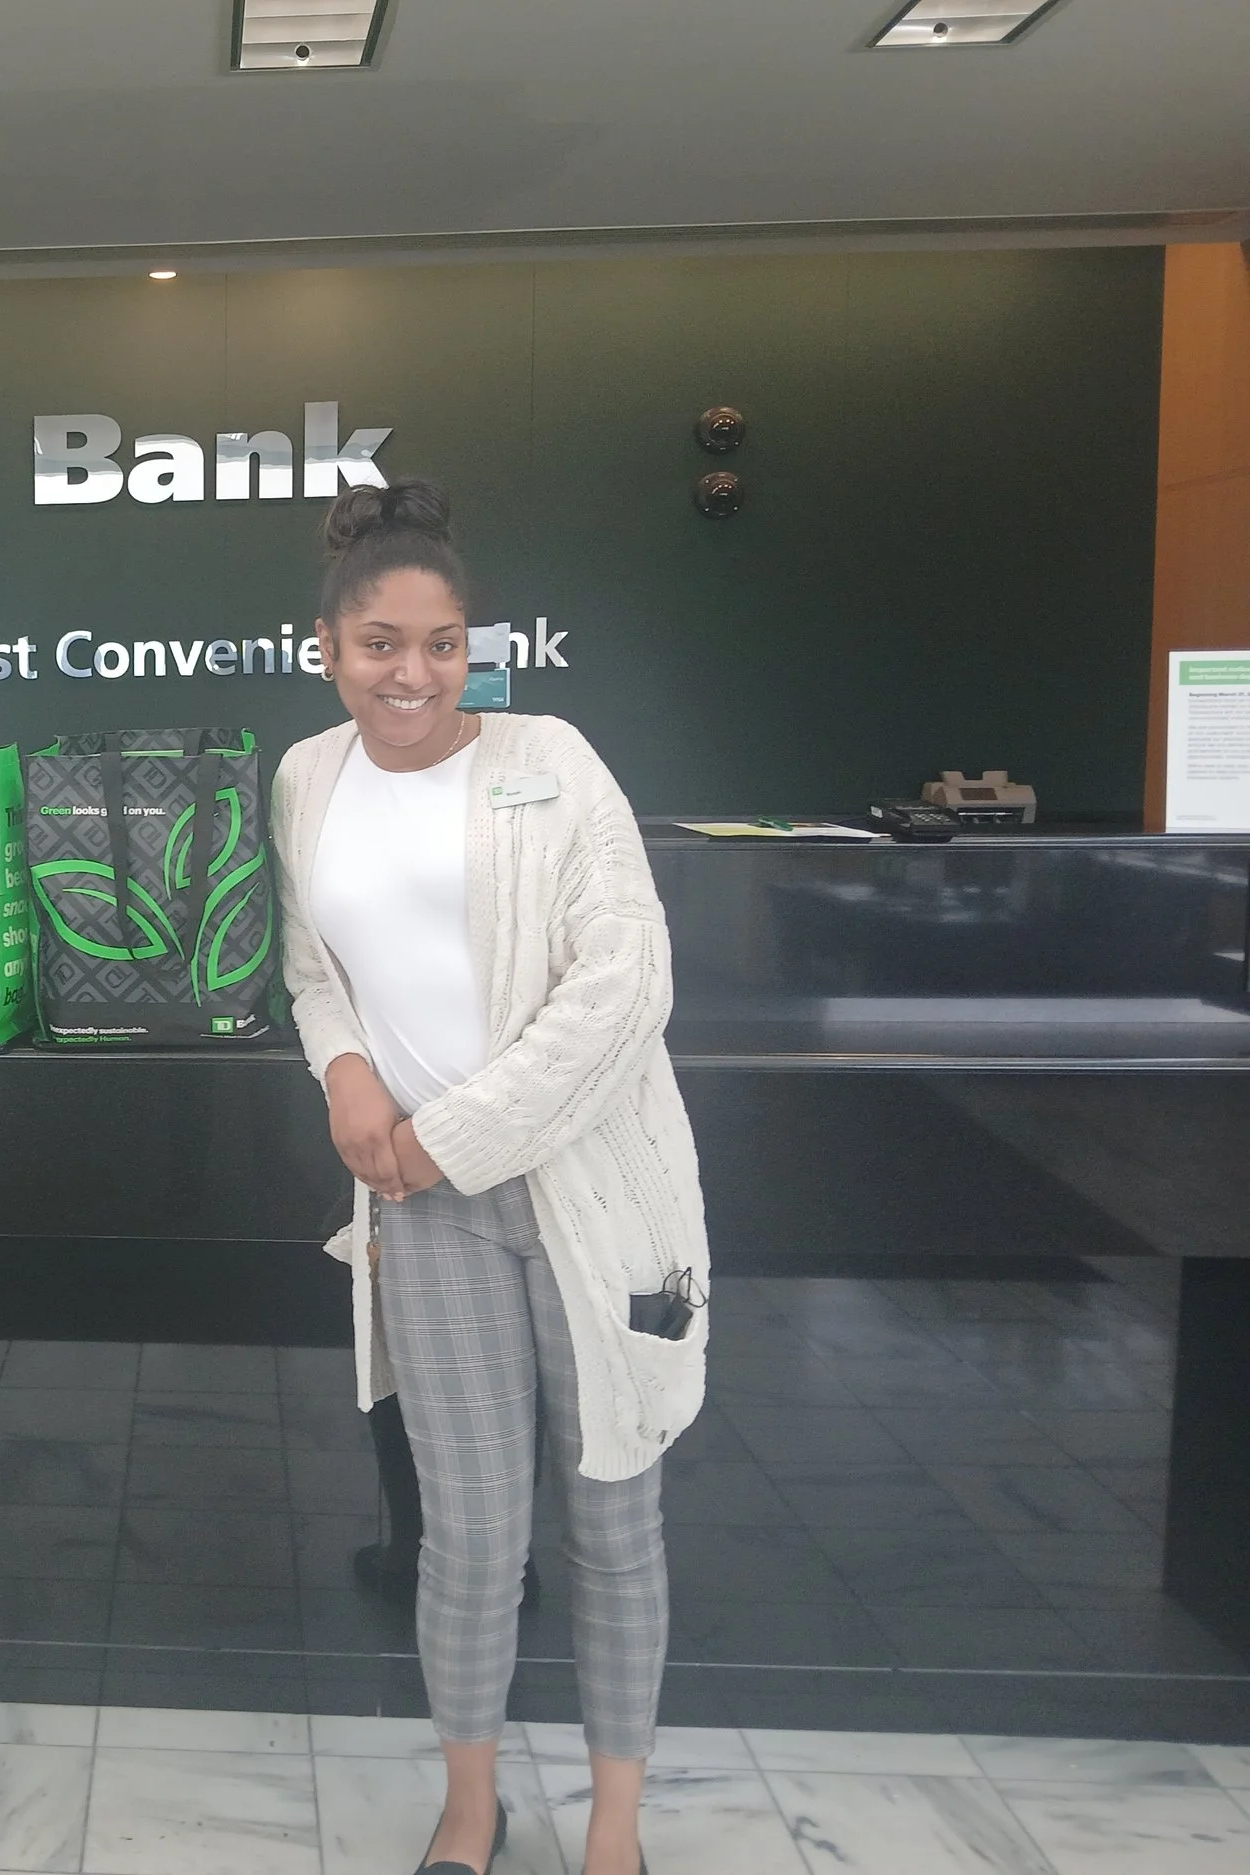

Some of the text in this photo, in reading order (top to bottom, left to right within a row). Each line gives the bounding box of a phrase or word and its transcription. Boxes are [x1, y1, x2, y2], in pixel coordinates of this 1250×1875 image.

[34, 401, 394, 505] Bank
[55, 623, 323, 679] Convenie
[510, 616, 569, 669] nk
[40, 806, 71, 816] Green
[72, 806, 100, 816] looks
[128, 808, 142, 816] on
[143, 808, 166, 817] you.
[99, 1026, 149, 1034] sustainable.
[100, 1035, 132, 1043] Human.
